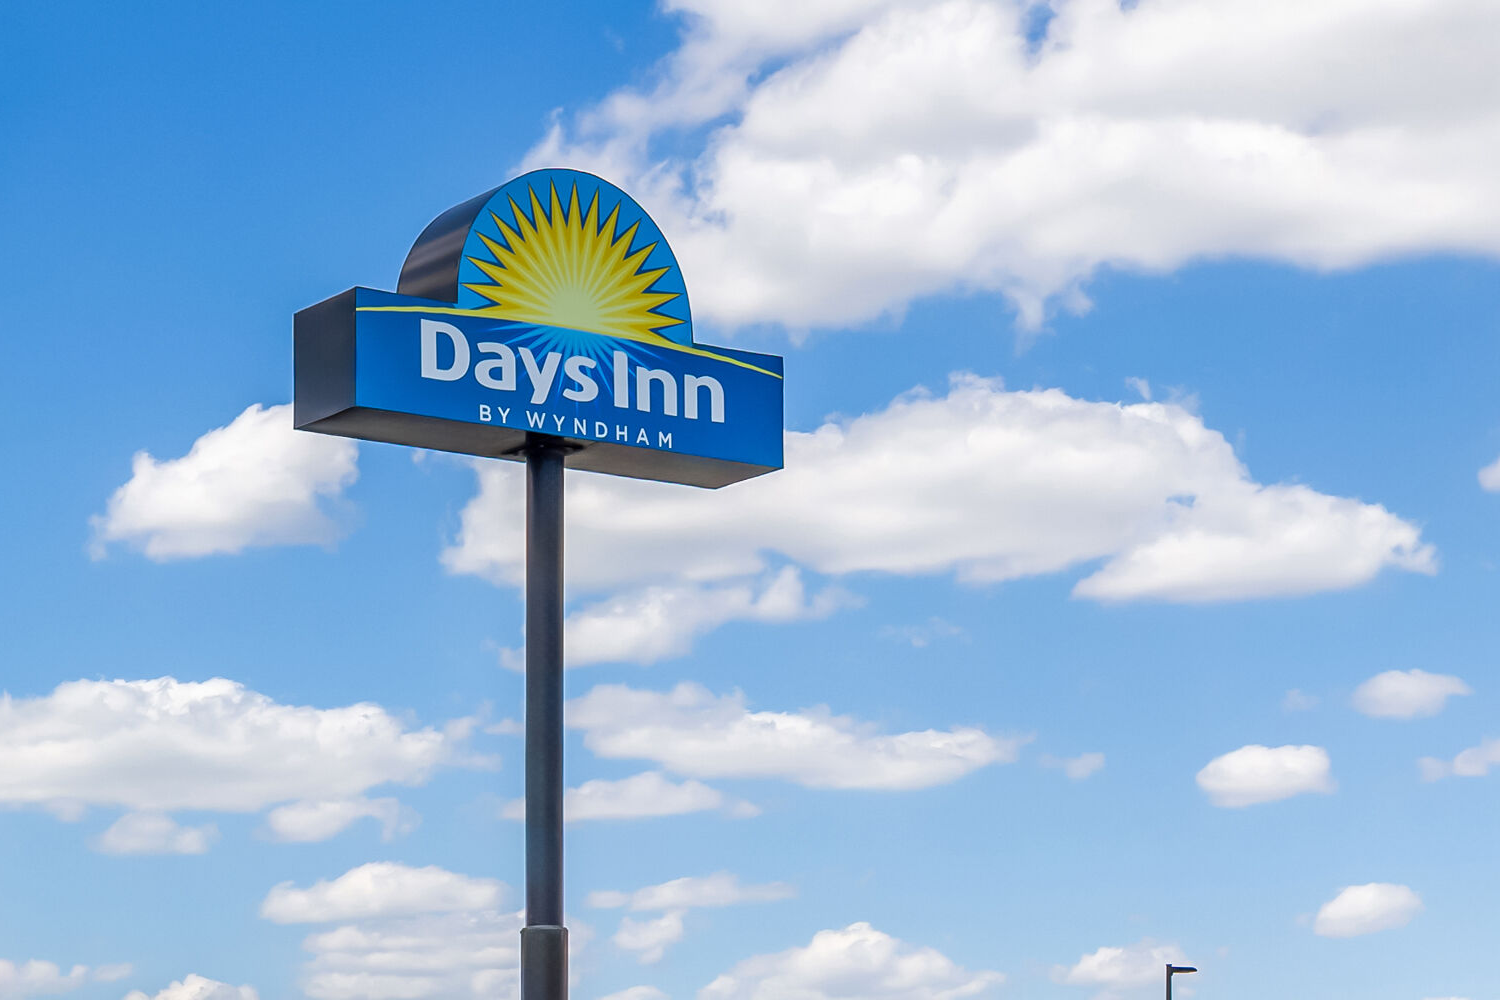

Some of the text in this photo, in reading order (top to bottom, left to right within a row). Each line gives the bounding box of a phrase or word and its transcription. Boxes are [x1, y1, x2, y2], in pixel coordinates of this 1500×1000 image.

[420, 318, 725, 424] Days Inn
[478, 404, 673, 449] BY WYNDHAM
